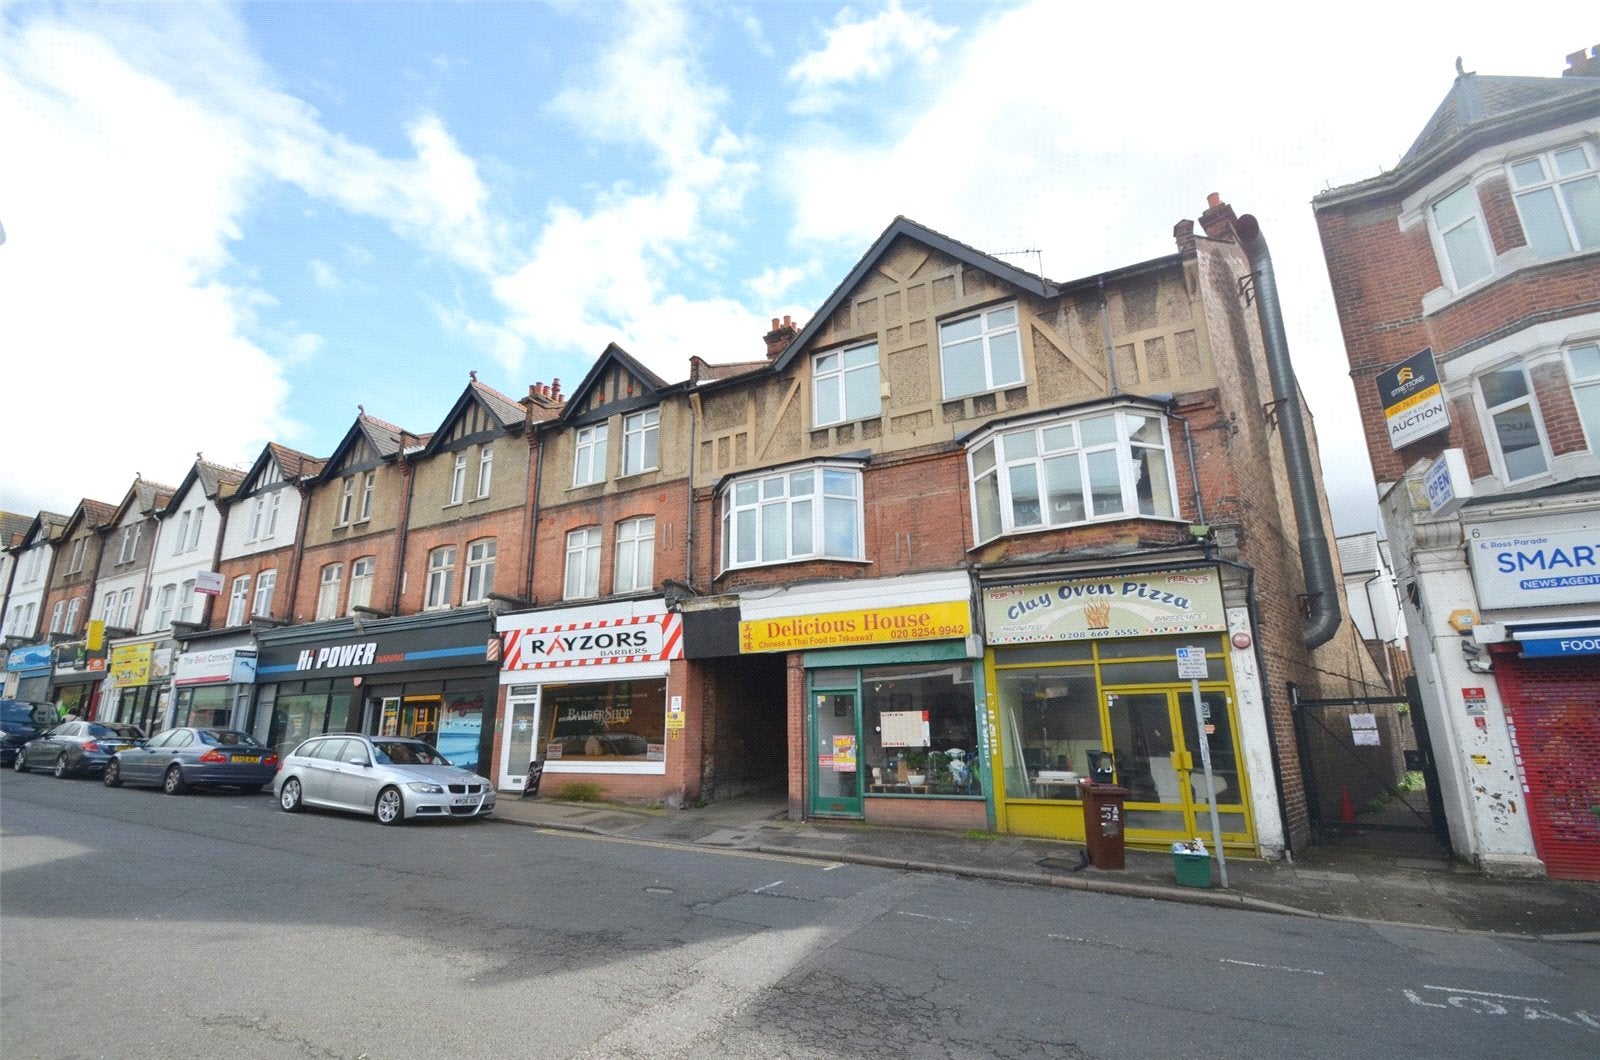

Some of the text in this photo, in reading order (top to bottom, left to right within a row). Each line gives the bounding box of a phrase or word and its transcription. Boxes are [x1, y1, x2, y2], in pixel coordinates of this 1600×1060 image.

[1391, 374, 1425, 396] STRETTONS
[1392, 404, 1442, 434] AUCTION
[1428, 470, 1450, 500] OPEN
[1472, 528, 1480, 538] 6
[1514, 538, 1548, 546] Parade
[1497, 544, 1600, 573] SMAR
[1523, 578, 1557, 588] NEWS
[1008, 582, 1189, 620] Clay Oven Pizza
[767, 613, 930, 638] Delicious House
[891, 624, 964, 639] 020 8254 9942
[532, 631, 647, 656] RAYZORS
[838, 633, 873, 642] Takeaway
[296, 648, 315, 670] Hi
[316, 642, 377, 669] POWER
[600, 648, 647, 656] BARBERS
